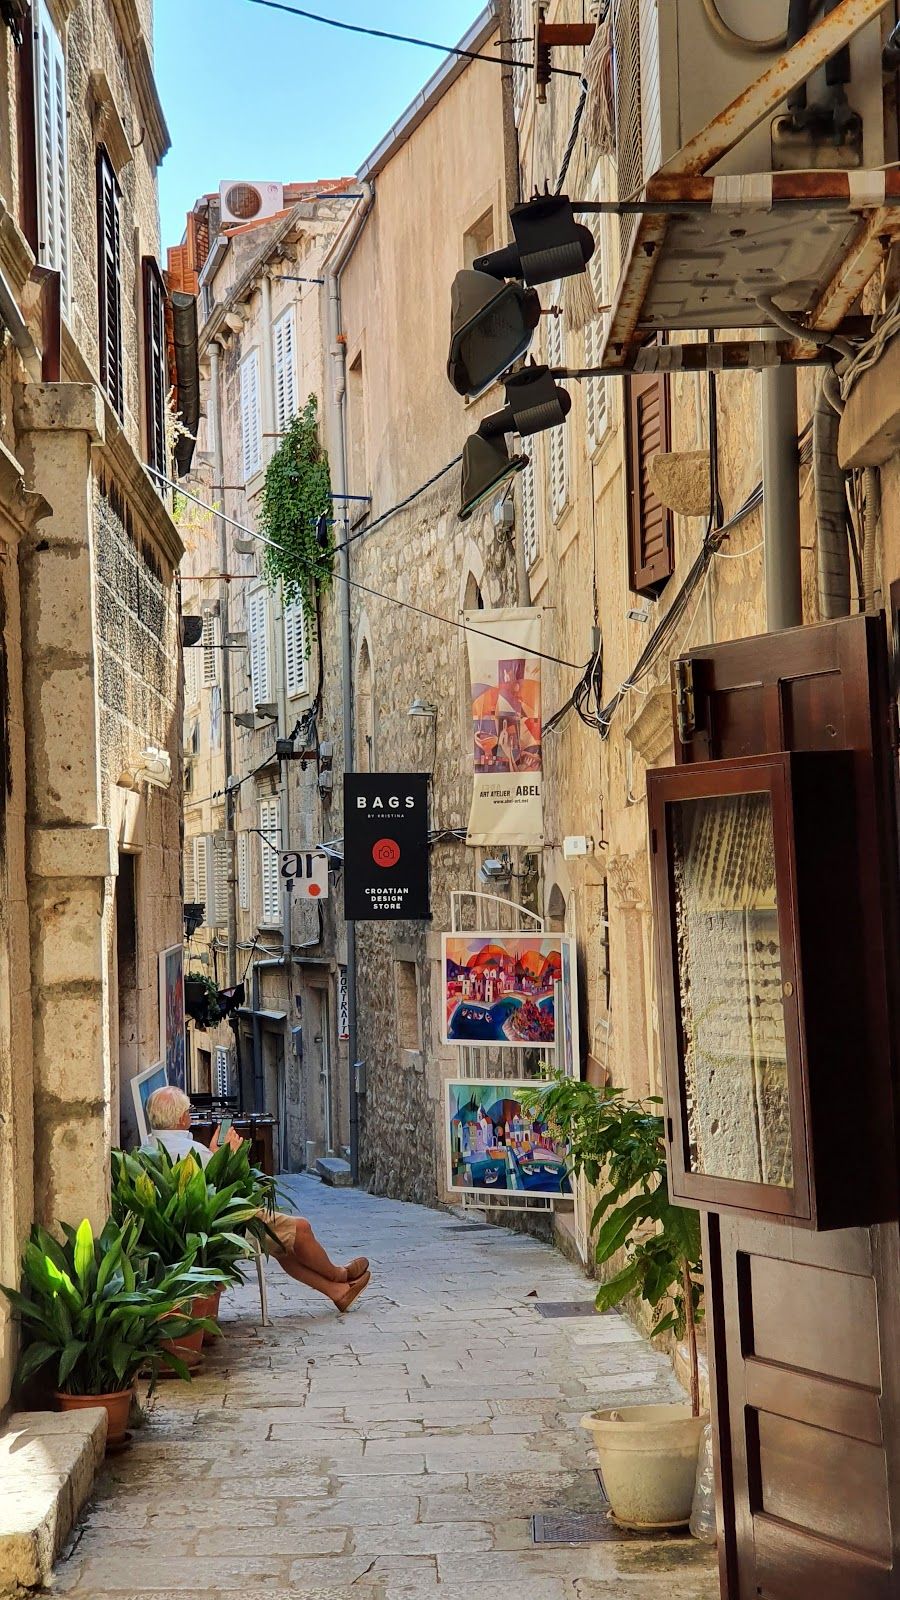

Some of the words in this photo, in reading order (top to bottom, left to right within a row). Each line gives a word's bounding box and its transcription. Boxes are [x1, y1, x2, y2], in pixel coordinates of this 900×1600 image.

[516, 785, 540, 796] ABEL
[357, 796, 415, 808] BAGS
[340, 969, 348, 1034] PORTRAIT
